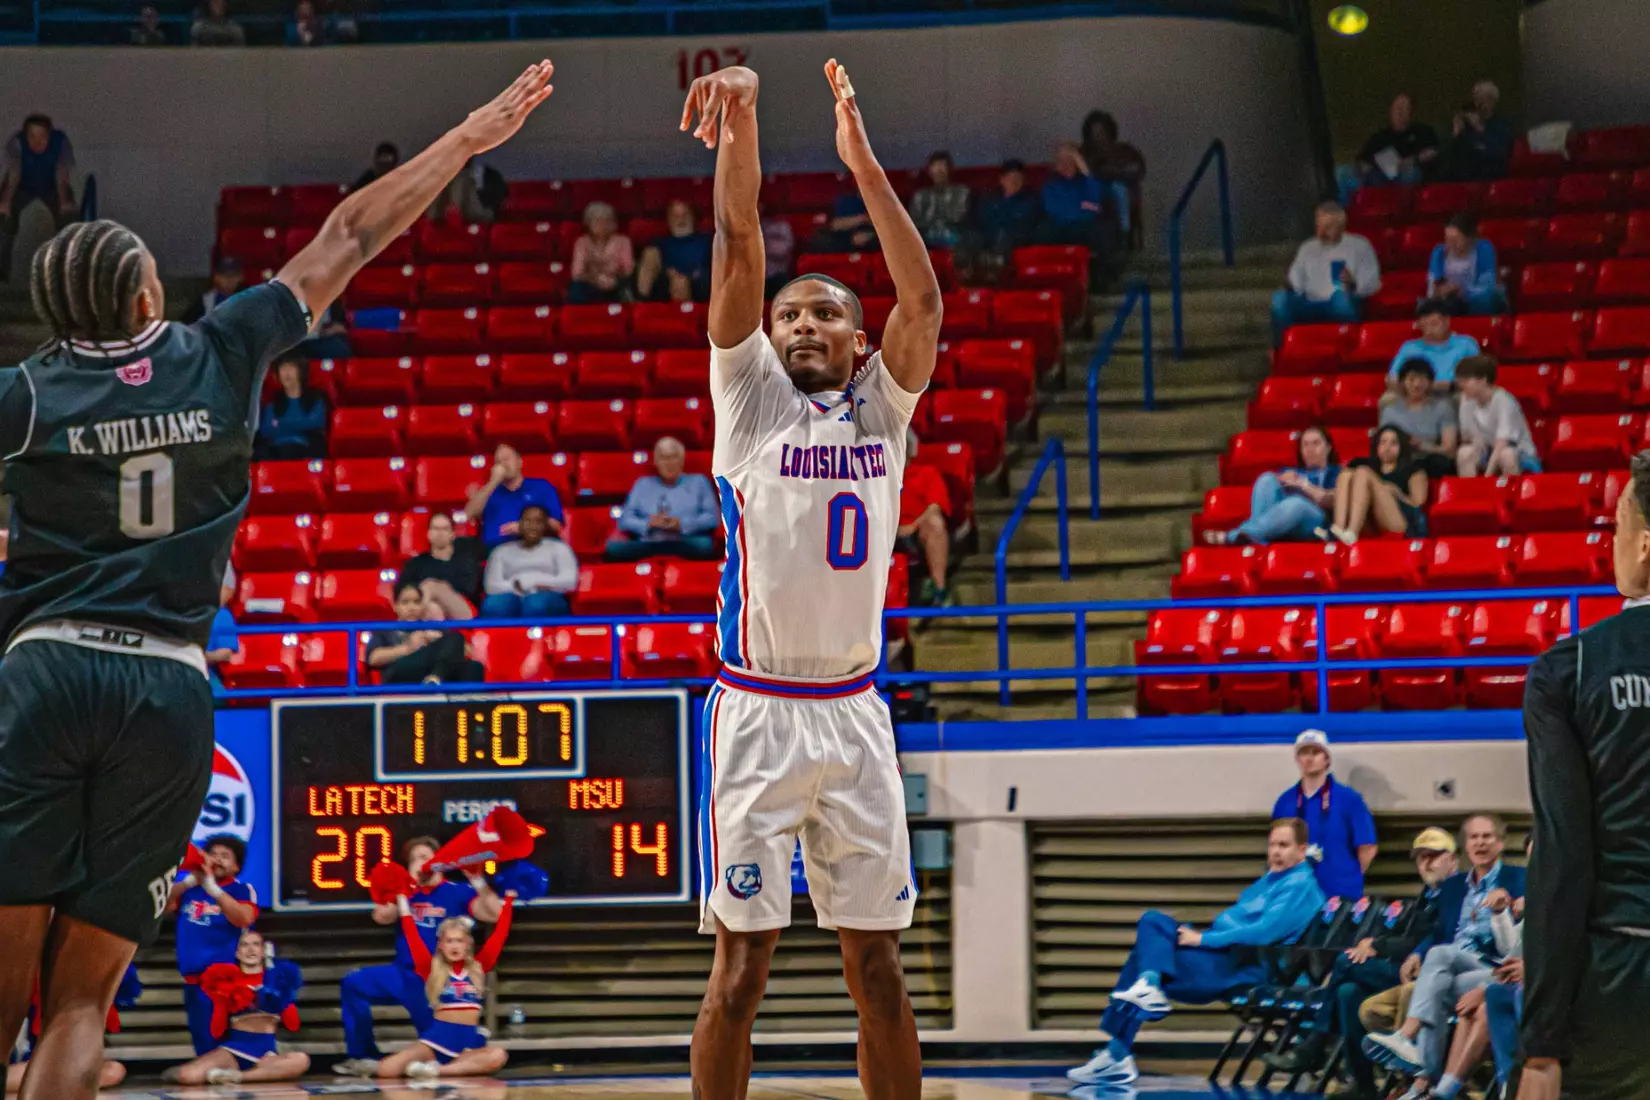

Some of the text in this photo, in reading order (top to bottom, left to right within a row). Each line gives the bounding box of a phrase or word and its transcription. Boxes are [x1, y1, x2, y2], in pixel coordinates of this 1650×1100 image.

[67, 409, 212, 455] K. WILLIAMS
[119, 452, 175, 539] 0
[826, 491, 869, 571] 0
[414, 703, 571, 766] 11:07
[569, 778, 623, 809] MSU
[312, 825, 392, 889] 20
[612, 822, 669, 878] 14
